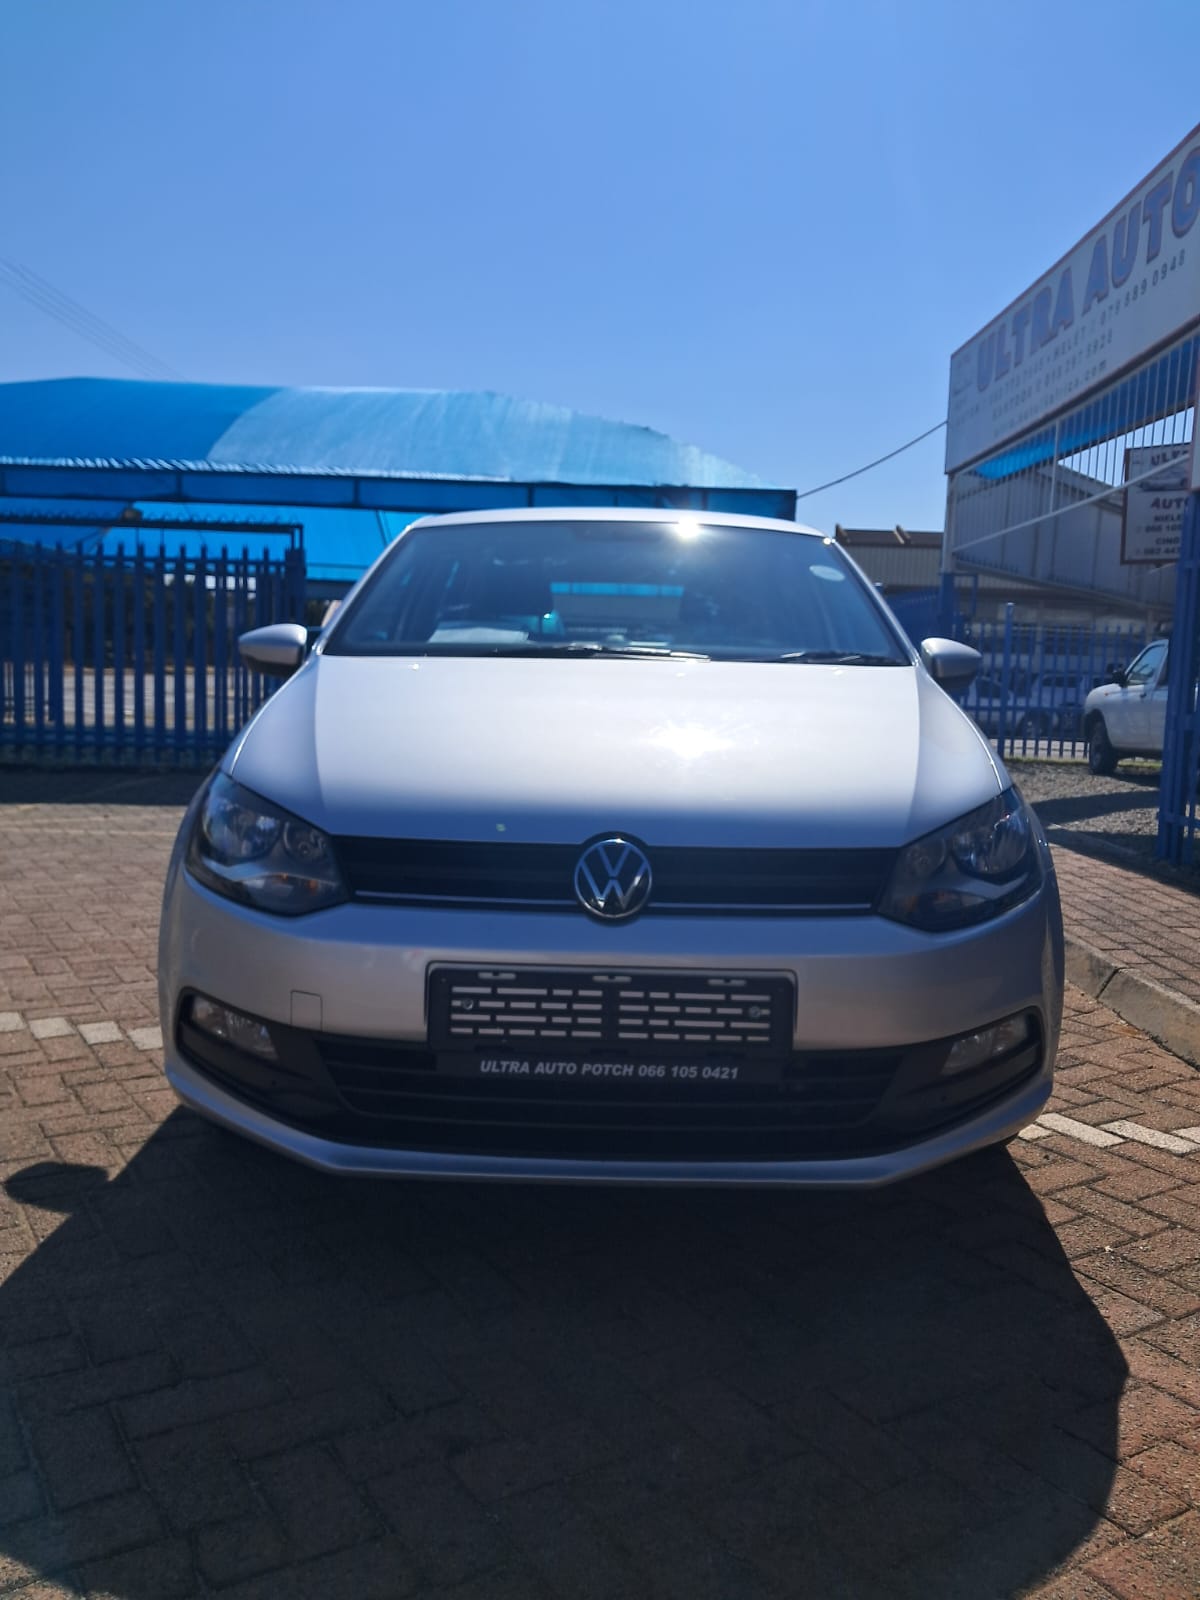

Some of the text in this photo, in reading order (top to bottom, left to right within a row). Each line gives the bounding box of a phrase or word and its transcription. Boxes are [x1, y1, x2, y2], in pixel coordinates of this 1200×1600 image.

[976, 266, 1074, 392] ULTRA
[1081, 145, 1200, 317] AUTO
[480, 1060, 739, 1080] ULTRA AUTO POTCH 066 105 0421
